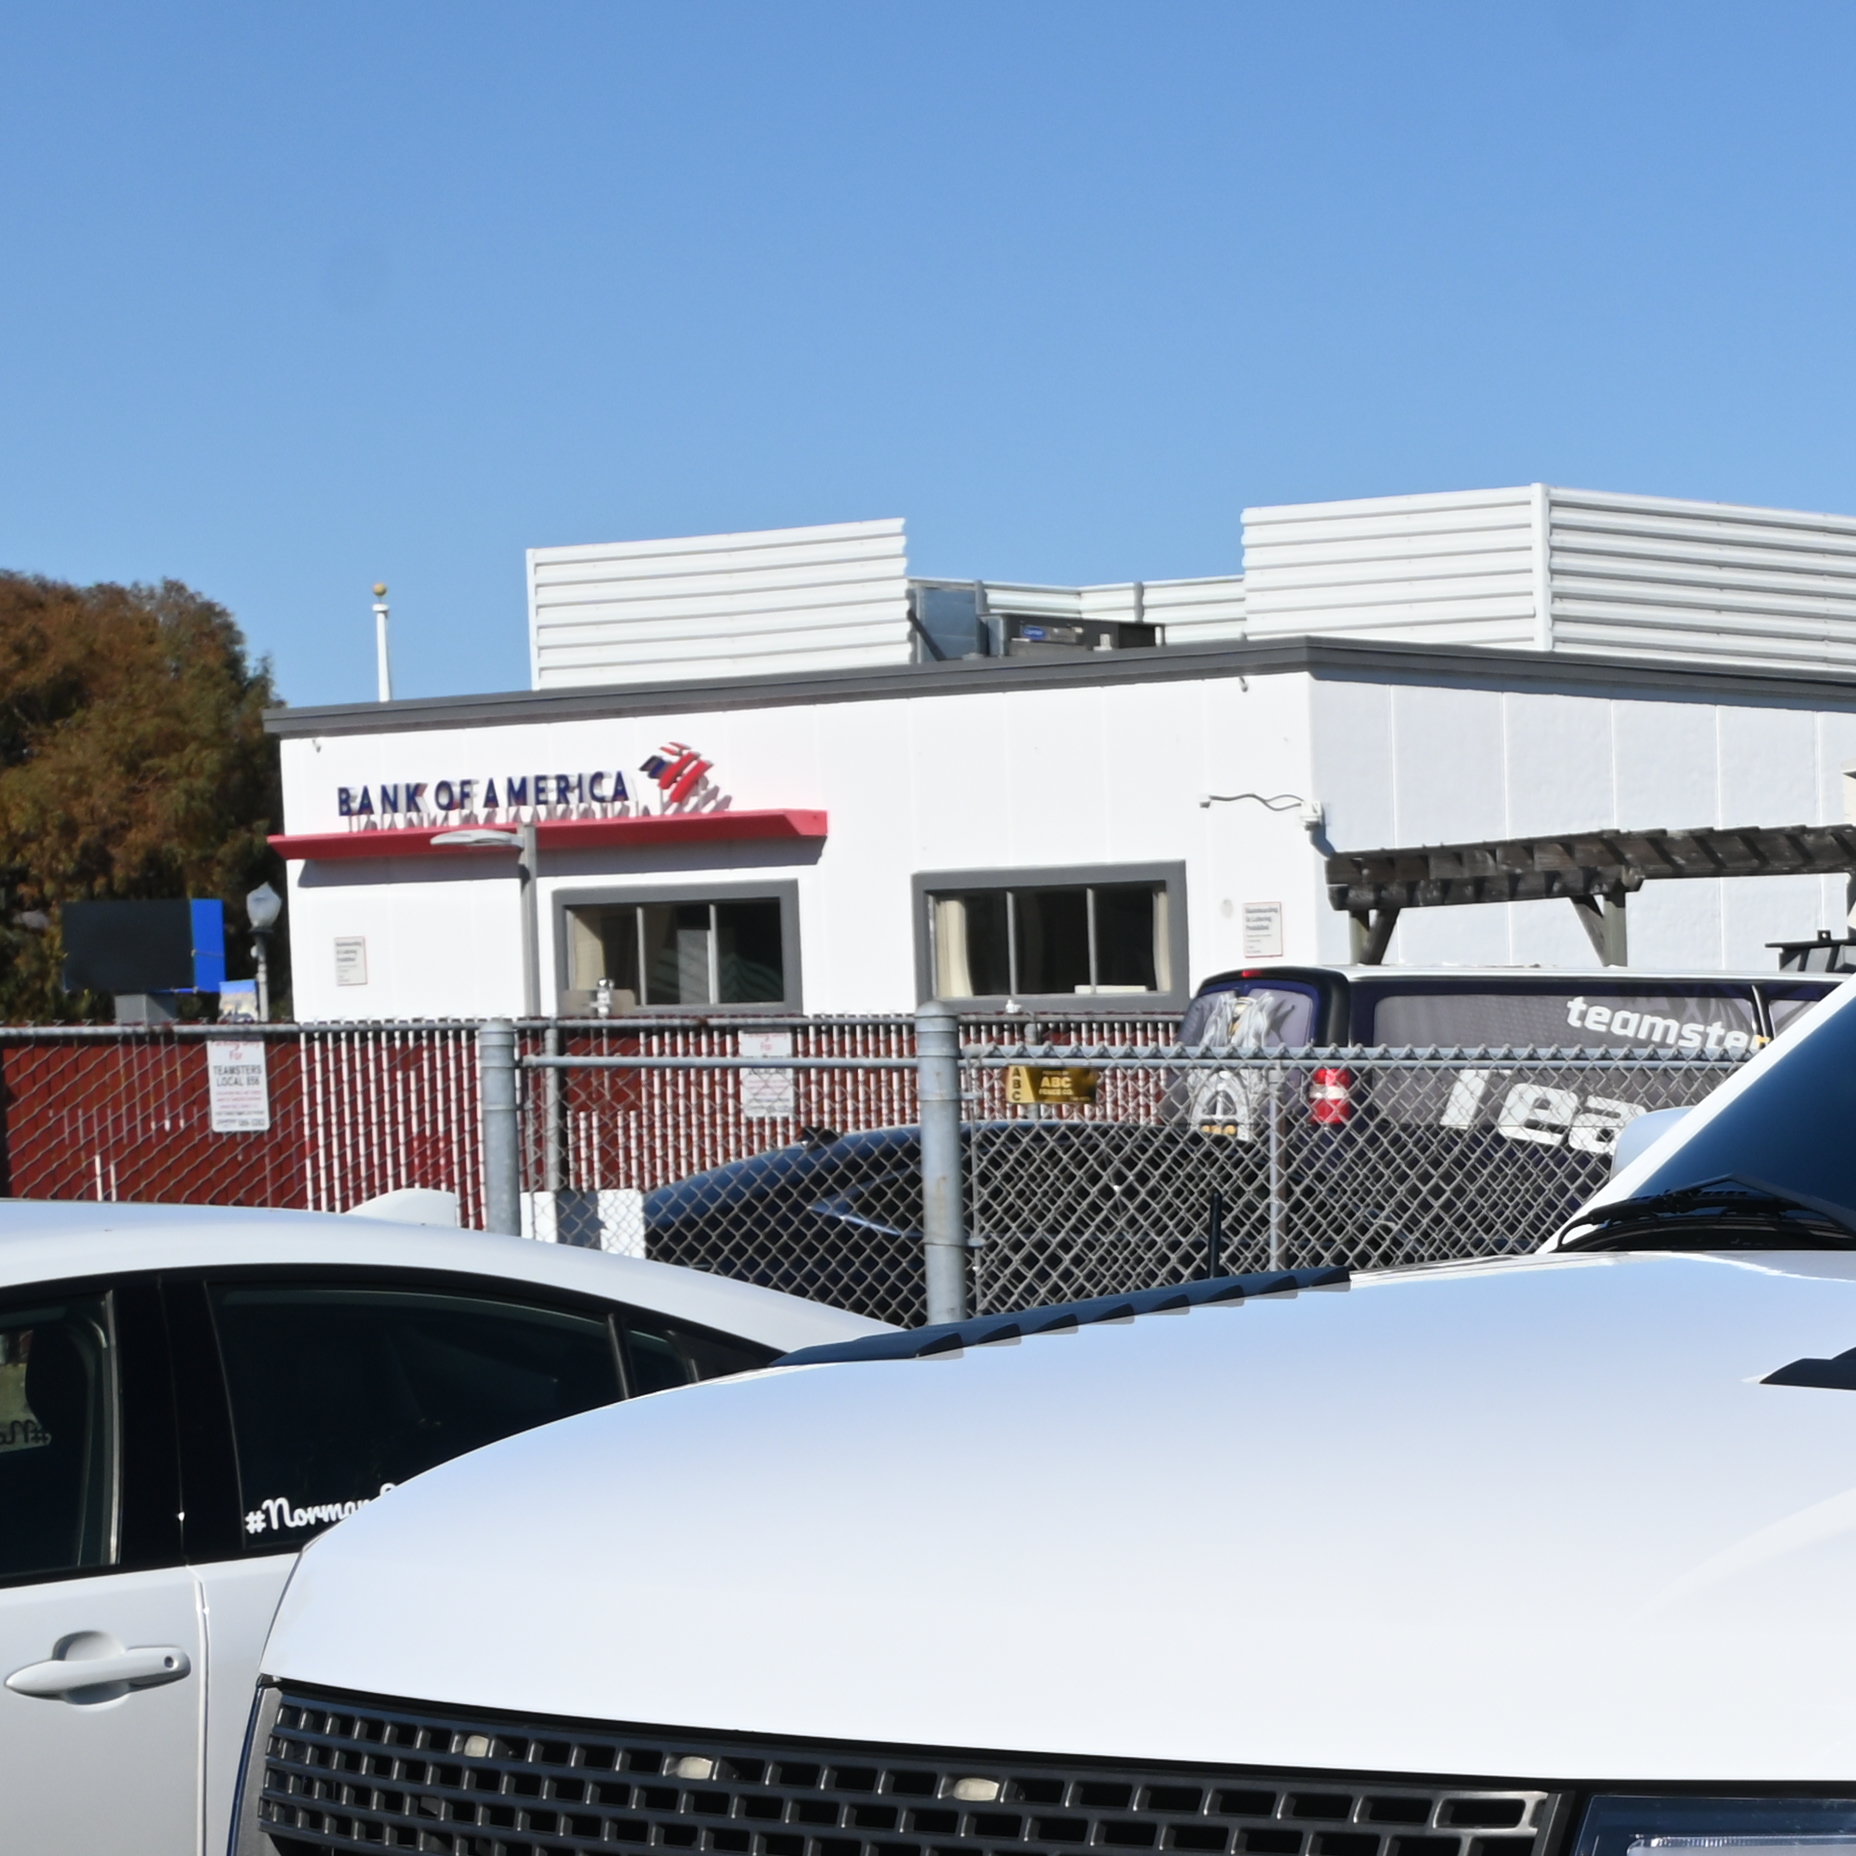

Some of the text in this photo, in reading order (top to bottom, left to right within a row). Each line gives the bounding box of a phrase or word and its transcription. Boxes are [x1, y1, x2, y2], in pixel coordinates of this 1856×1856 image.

[337, 770, 630, 817] BANK OF AMERICA
[213, 1064, 262, 1076] TEAMSTERS
[216, 1076, 244, 1088] LOCAL
[1041, 1076, 1072, 1088] ABC
